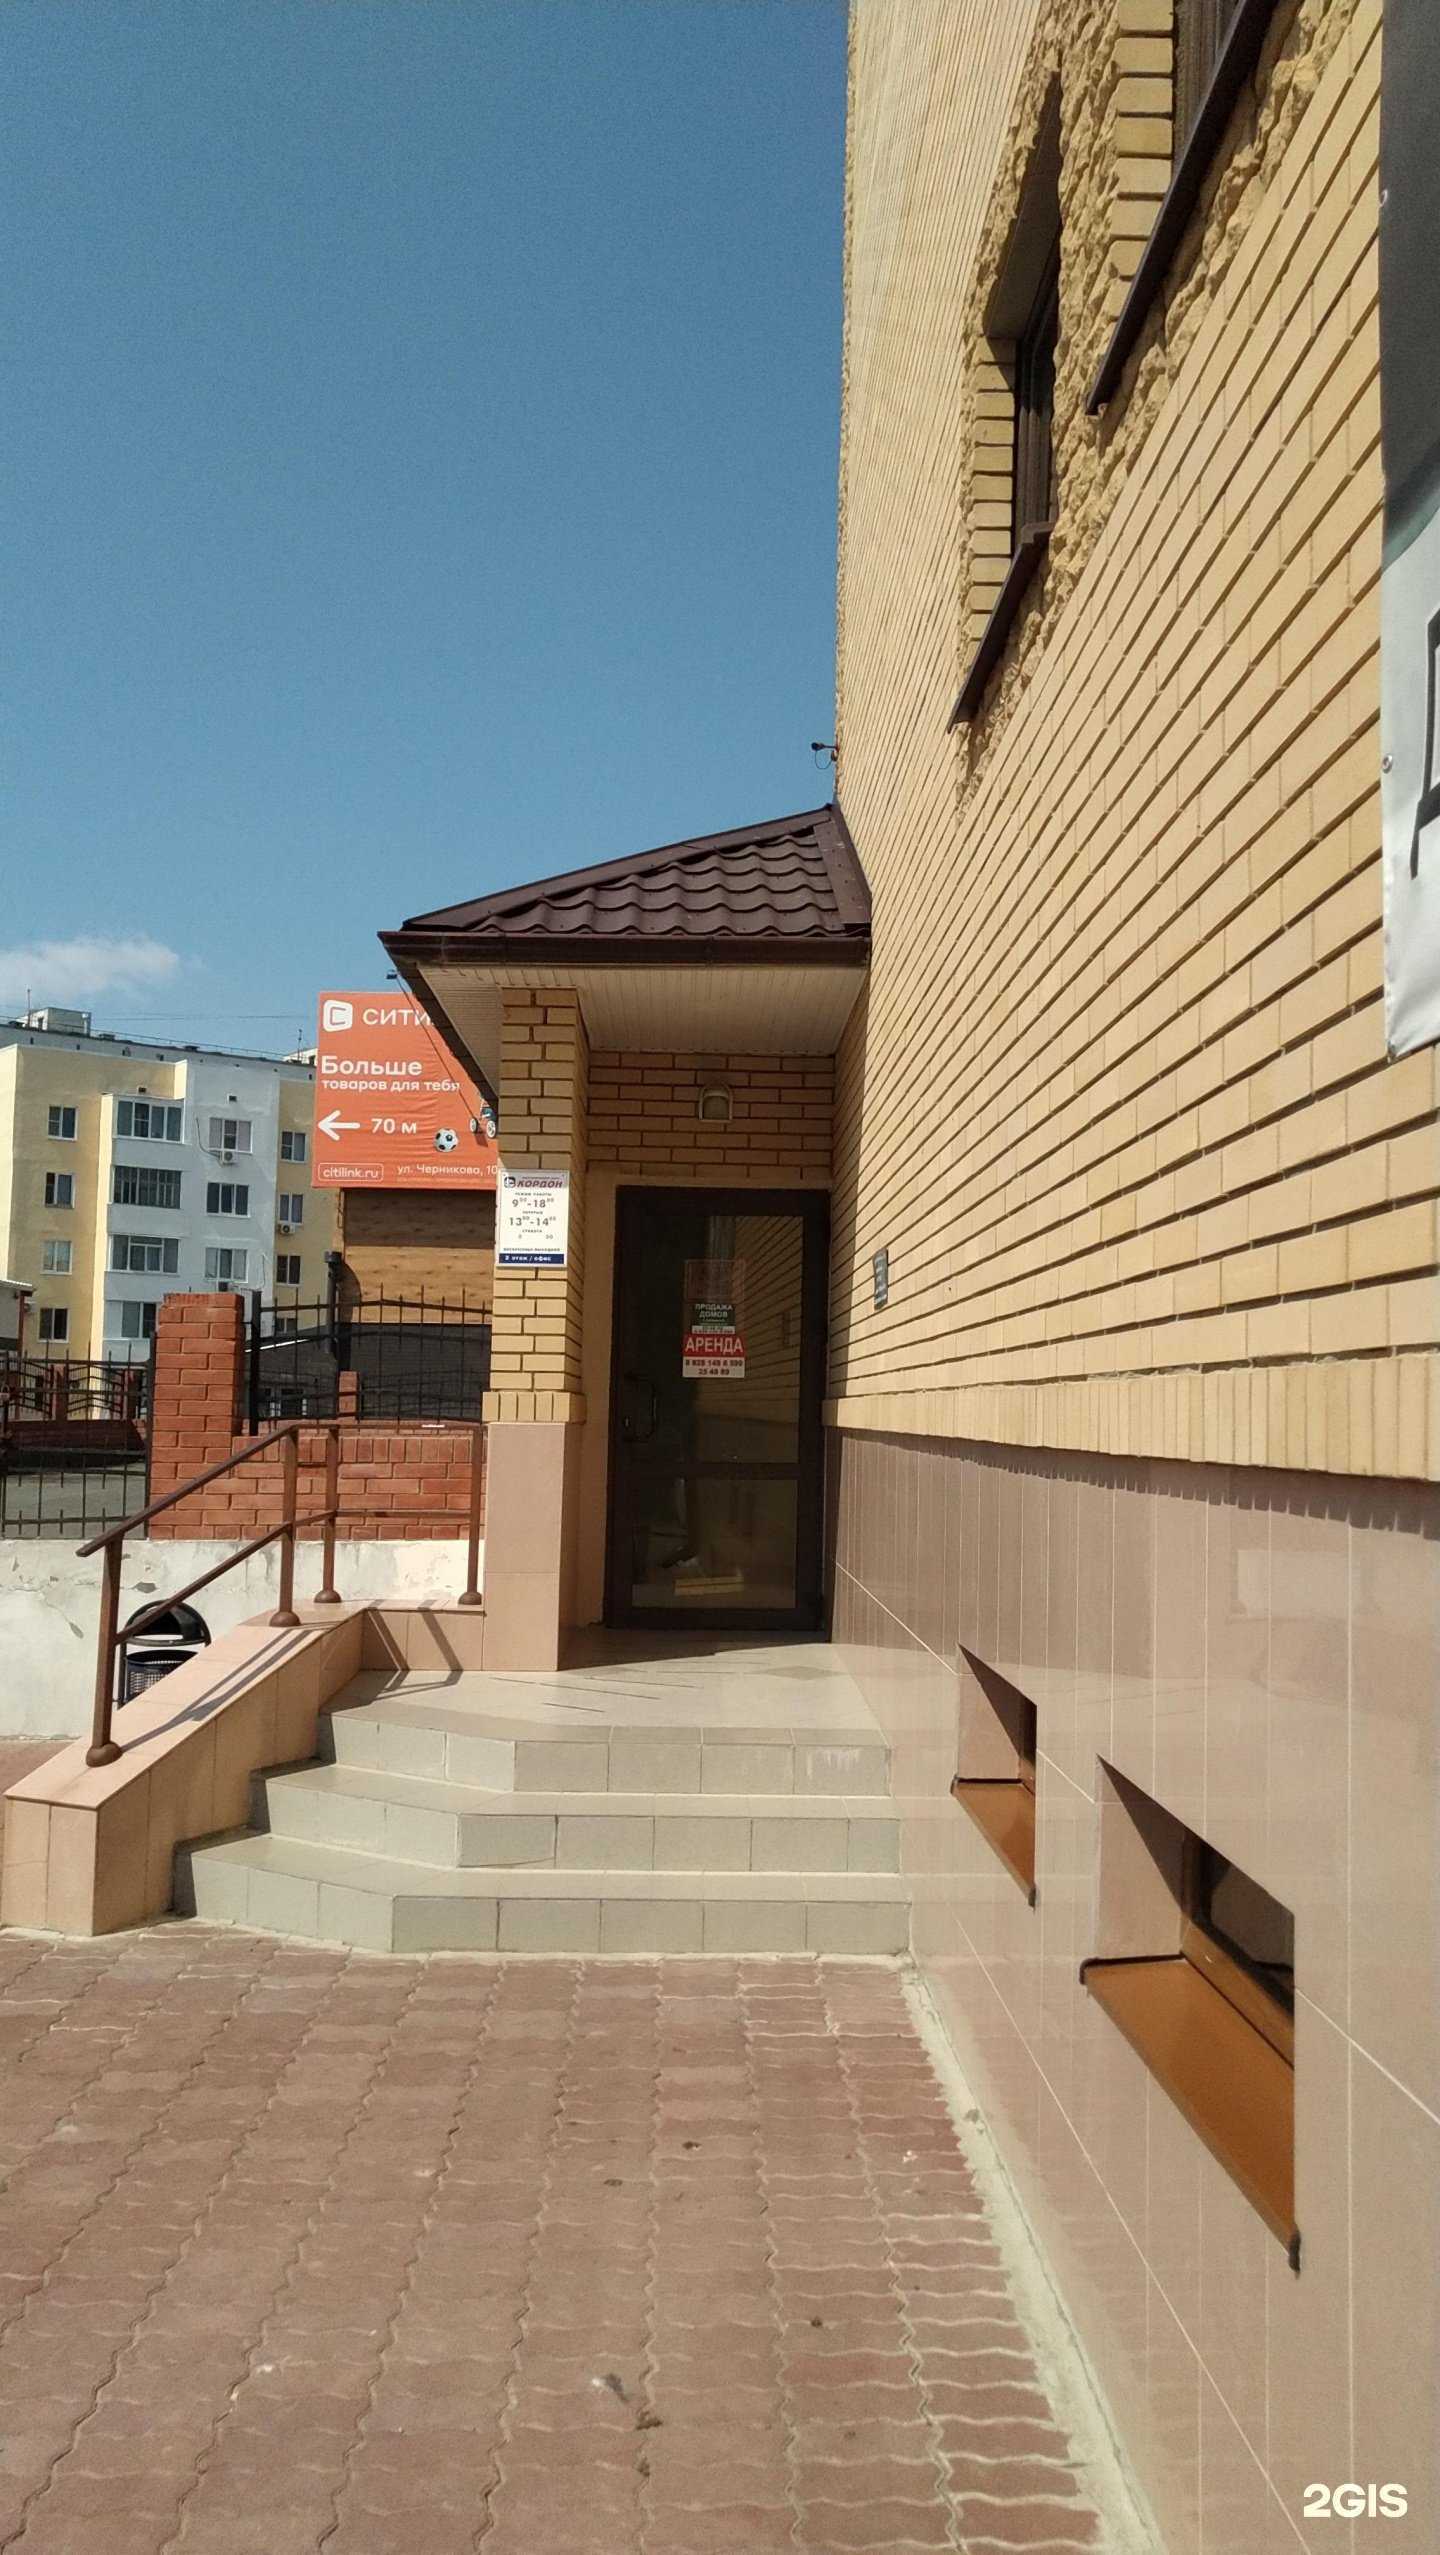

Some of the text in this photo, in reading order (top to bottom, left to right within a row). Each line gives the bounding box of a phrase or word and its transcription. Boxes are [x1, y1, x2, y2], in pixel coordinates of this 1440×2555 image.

[362, 1008, 434, 1026] СИТИ
[321, 1055, 423, 1076] Больше
[321, 1079, 460, 1092] товаров для тебя
[371, 1118, 417, 1134] 70 м
[323, 1167, 379, 1179] citilink.ru
[397, 1165, 414, 1175] ул.
[517, 1180, 563, 1189] КОРДОН
[695, 1303, 733, 1311] ПРОДАЖА
[699, 1311, 728, 1319] ДОМОВ
[685, 1337, 744, 1355] АРЕНДА
